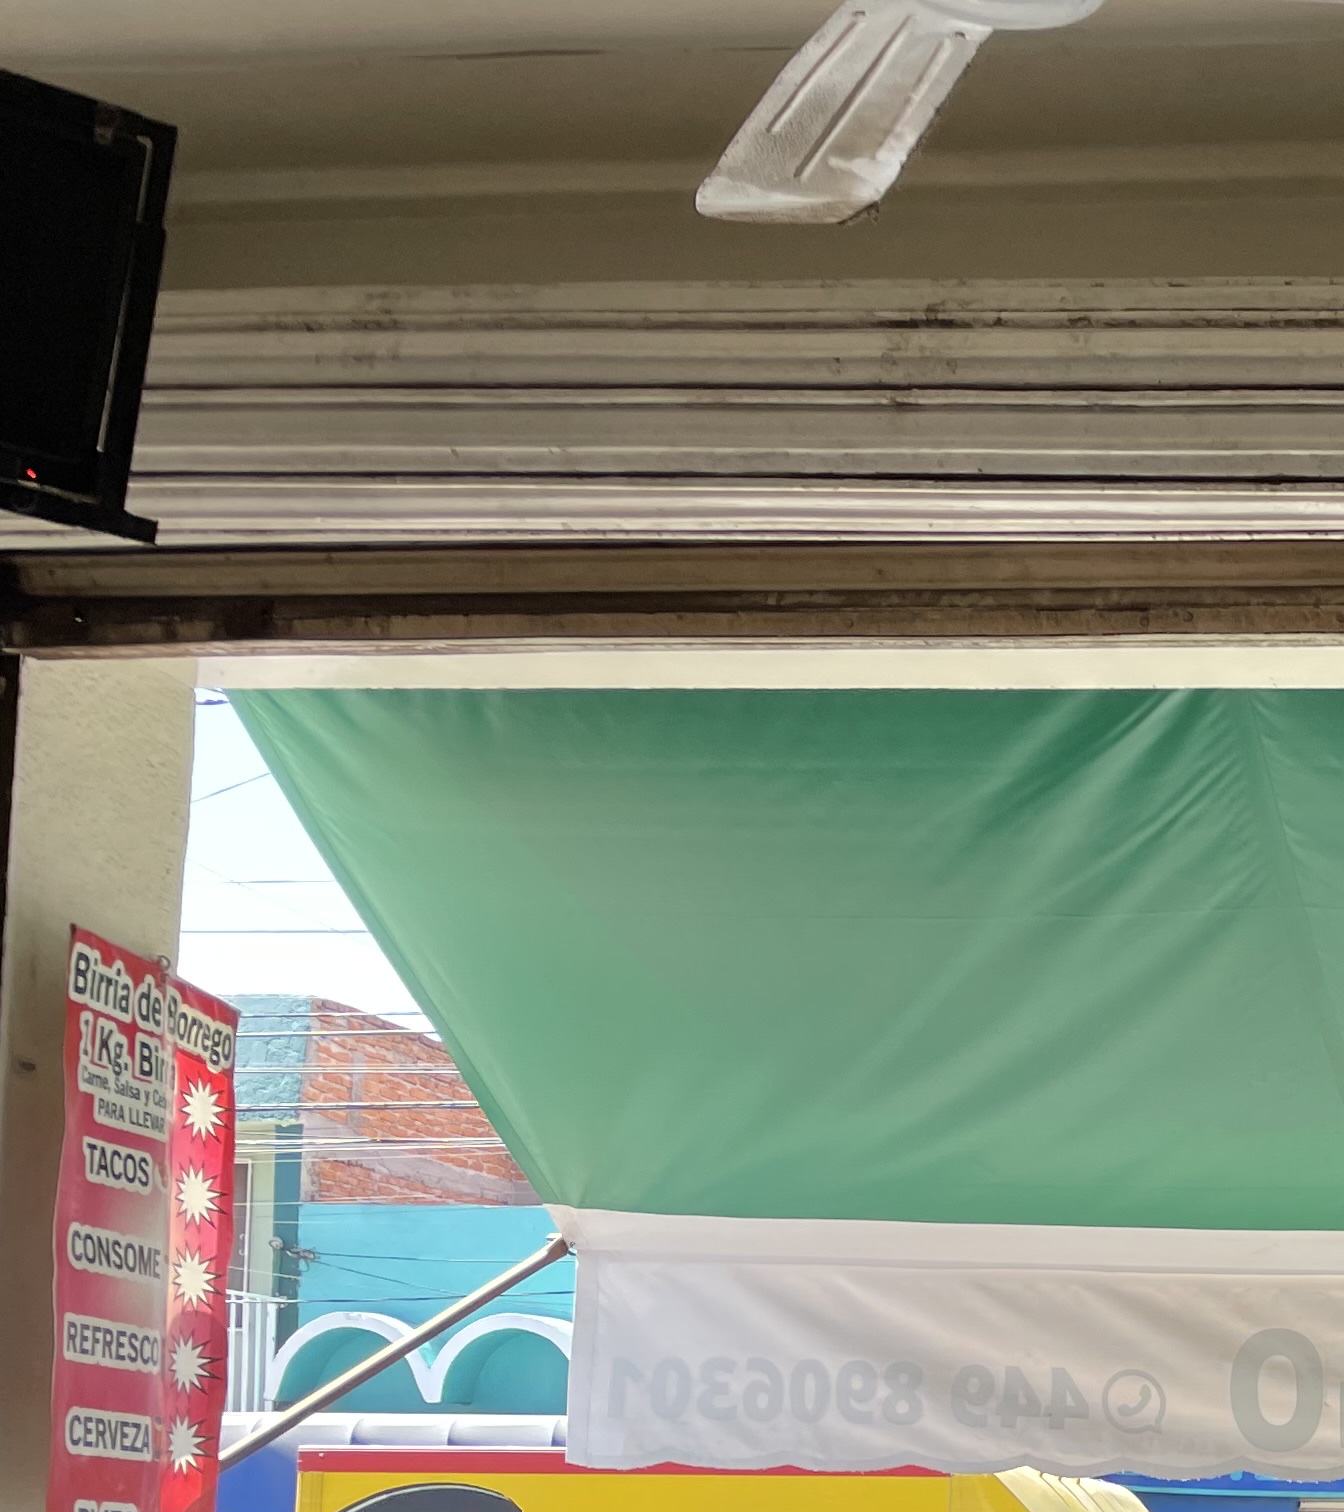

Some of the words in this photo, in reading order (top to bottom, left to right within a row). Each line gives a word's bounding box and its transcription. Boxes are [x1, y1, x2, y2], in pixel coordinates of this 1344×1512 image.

[74, 951, 130, 1015] Birria
[137, 984, 162, 1028] de
[167, 993, 232, 1067] Borrego
[98, 1025, 129, 1077] Kg.
[113, 1075, 141, 1101] Salsa
[143, 1088, 150, 1107] y
[97, 1097, 125, 1123] PARA
[128, 1109, 166, 1136] LLEVAR
[86, 1141, 150, 1188] TACOS
[71, 1229, 161, 1280] CONSOME
[66, 1320, 159, 1368] REFRESCO
[69, 1414, 150, 1455] CERVEZA
